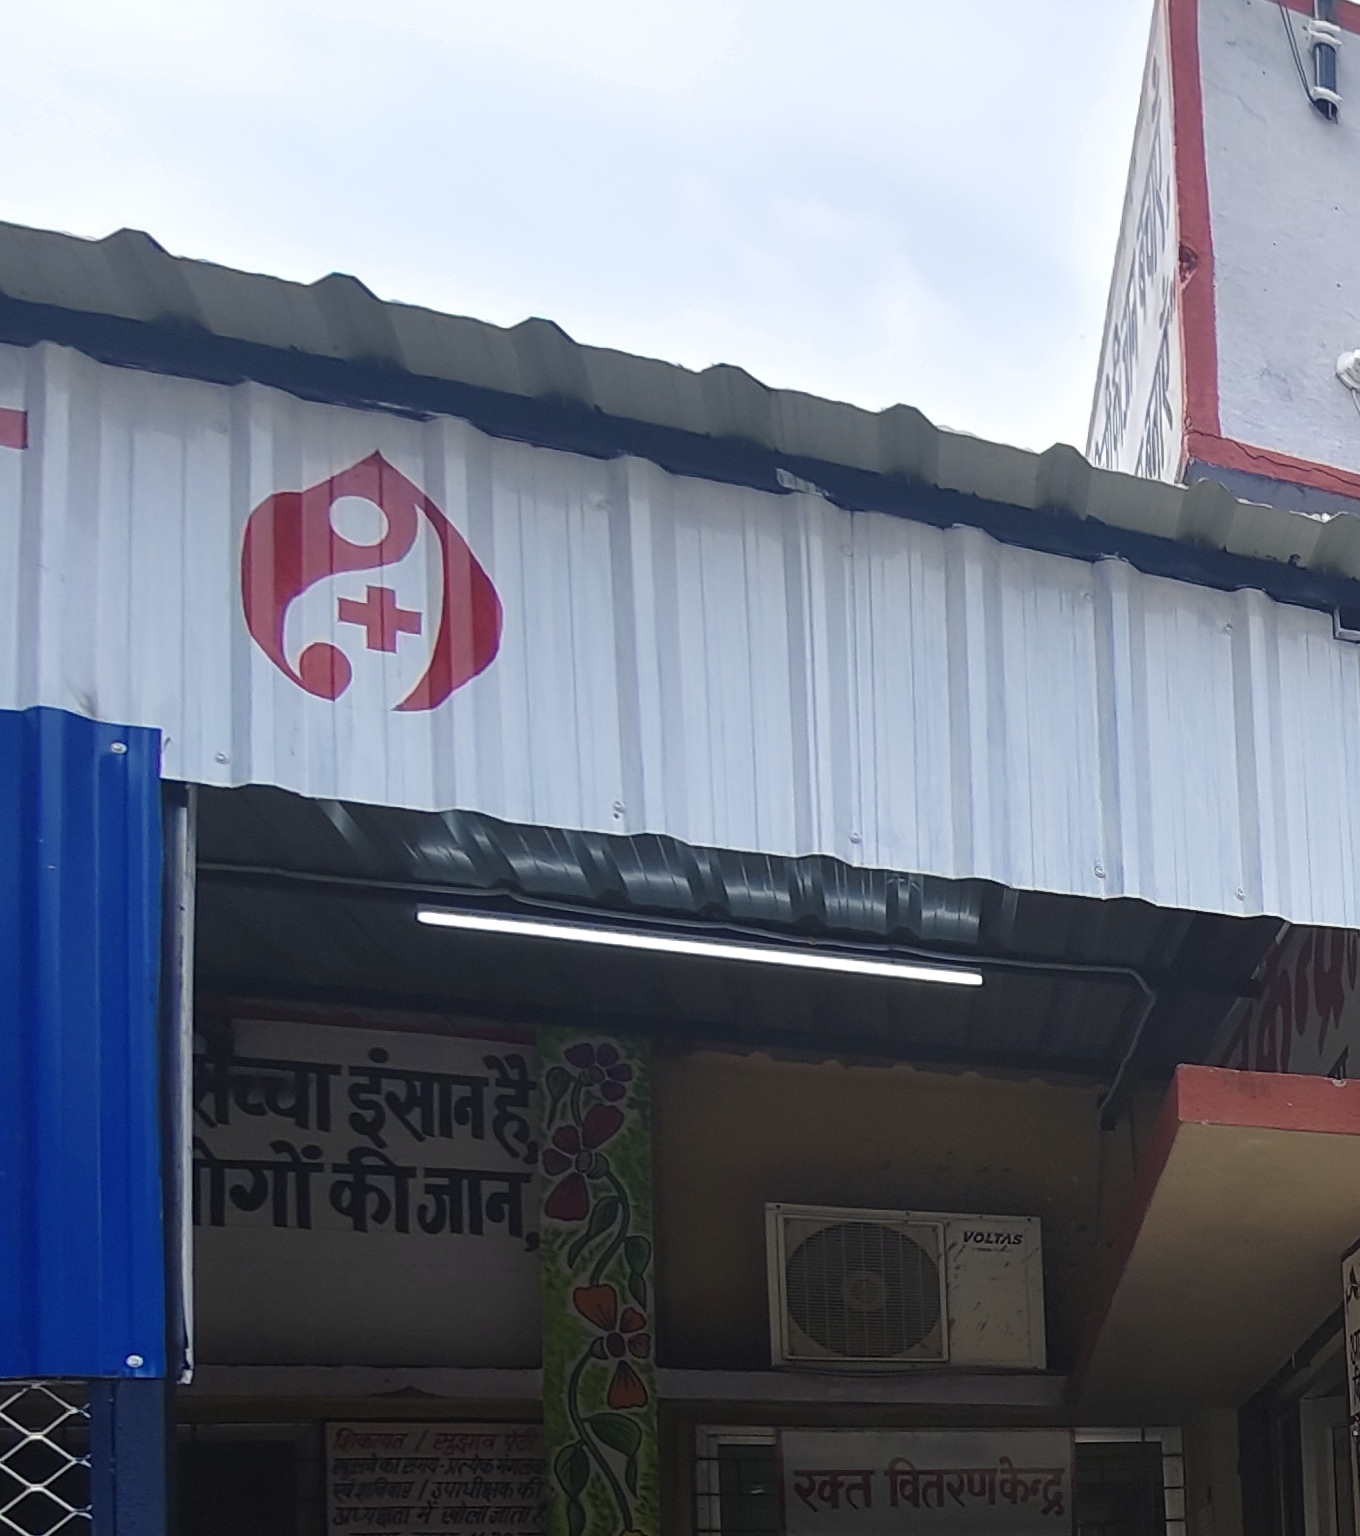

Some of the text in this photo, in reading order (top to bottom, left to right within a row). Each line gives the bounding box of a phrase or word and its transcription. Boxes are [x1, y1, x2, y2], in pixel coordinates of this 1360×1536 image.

[348, 1046, 489, 1148] इंसान
[193, 1136, 323, 1230] ोगों
[330, 1146, 416, 1234] की
[962, 1230, 1023, 1246] VOLTAS
[793, 1456, 1066, 1517] रक्त वितरण केन्द्र
